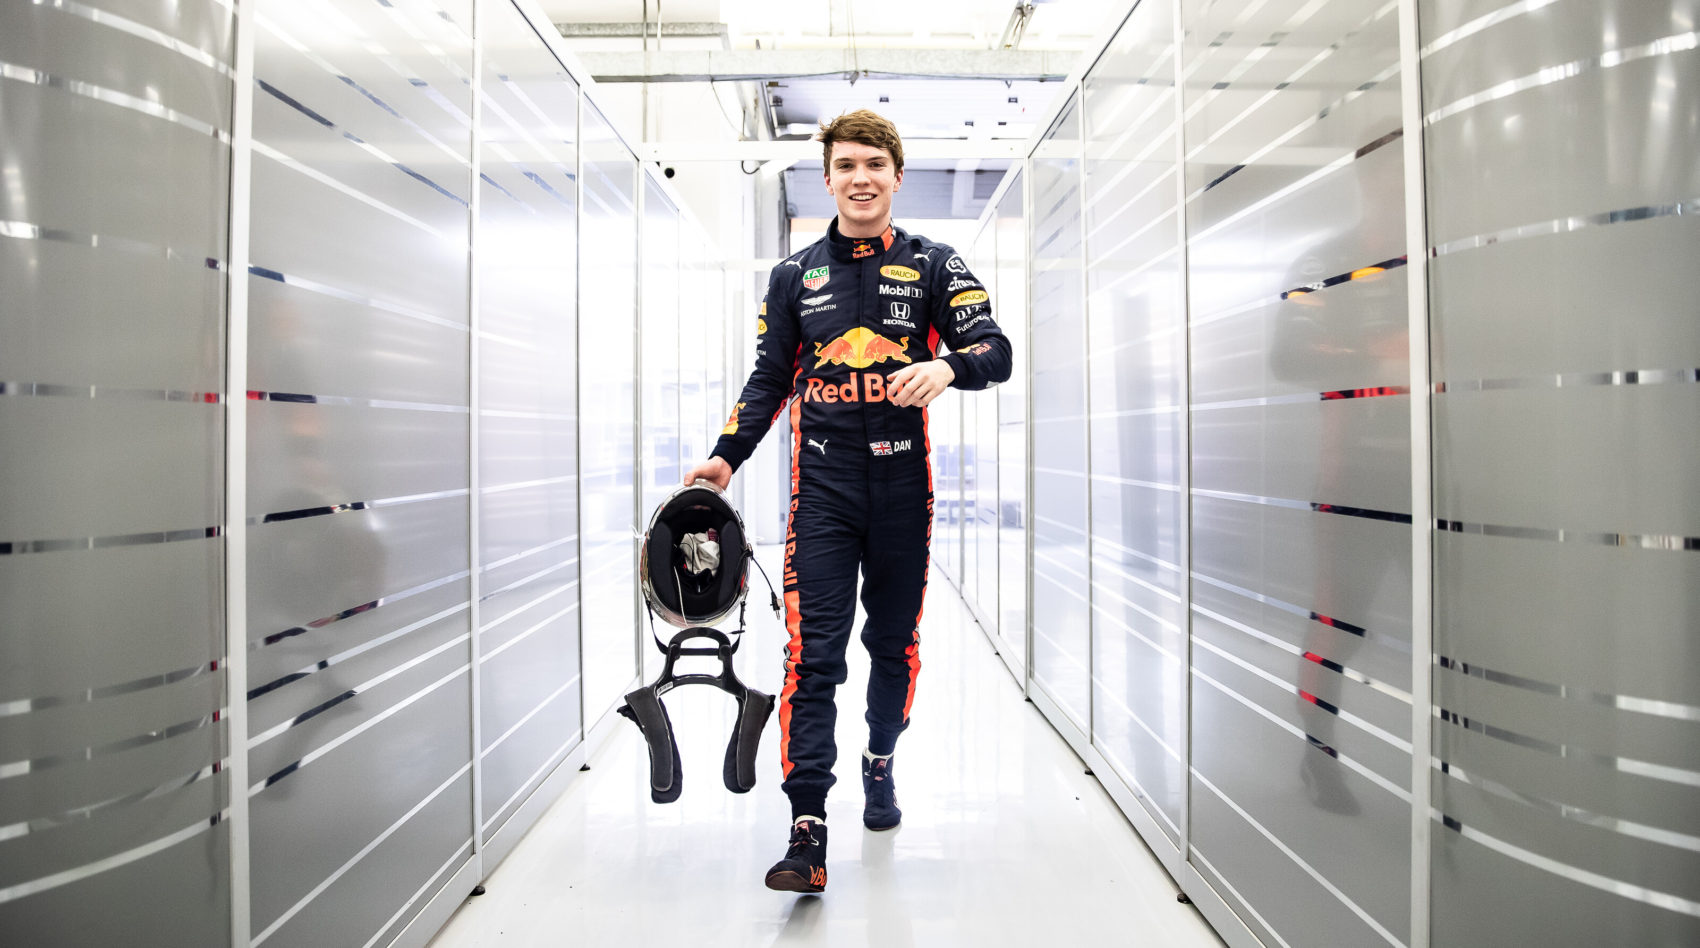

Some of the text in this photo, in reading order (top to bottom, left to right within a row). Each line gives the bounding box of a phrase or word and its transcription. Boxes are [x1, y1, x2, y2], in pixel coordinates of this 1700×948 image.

[864, 248, 875, 257] Bull
[806, 268, 827, 279] TAG
[890, 269, 916, 279] RAUCH
[879, 284, 910, 297] Mobil
[815, 304, 837, 313] MARTIN
[882, 318, 916, 329] HONDA
[804, 371, 859, 404] Red
[893, 440, 912, 453] DAN
